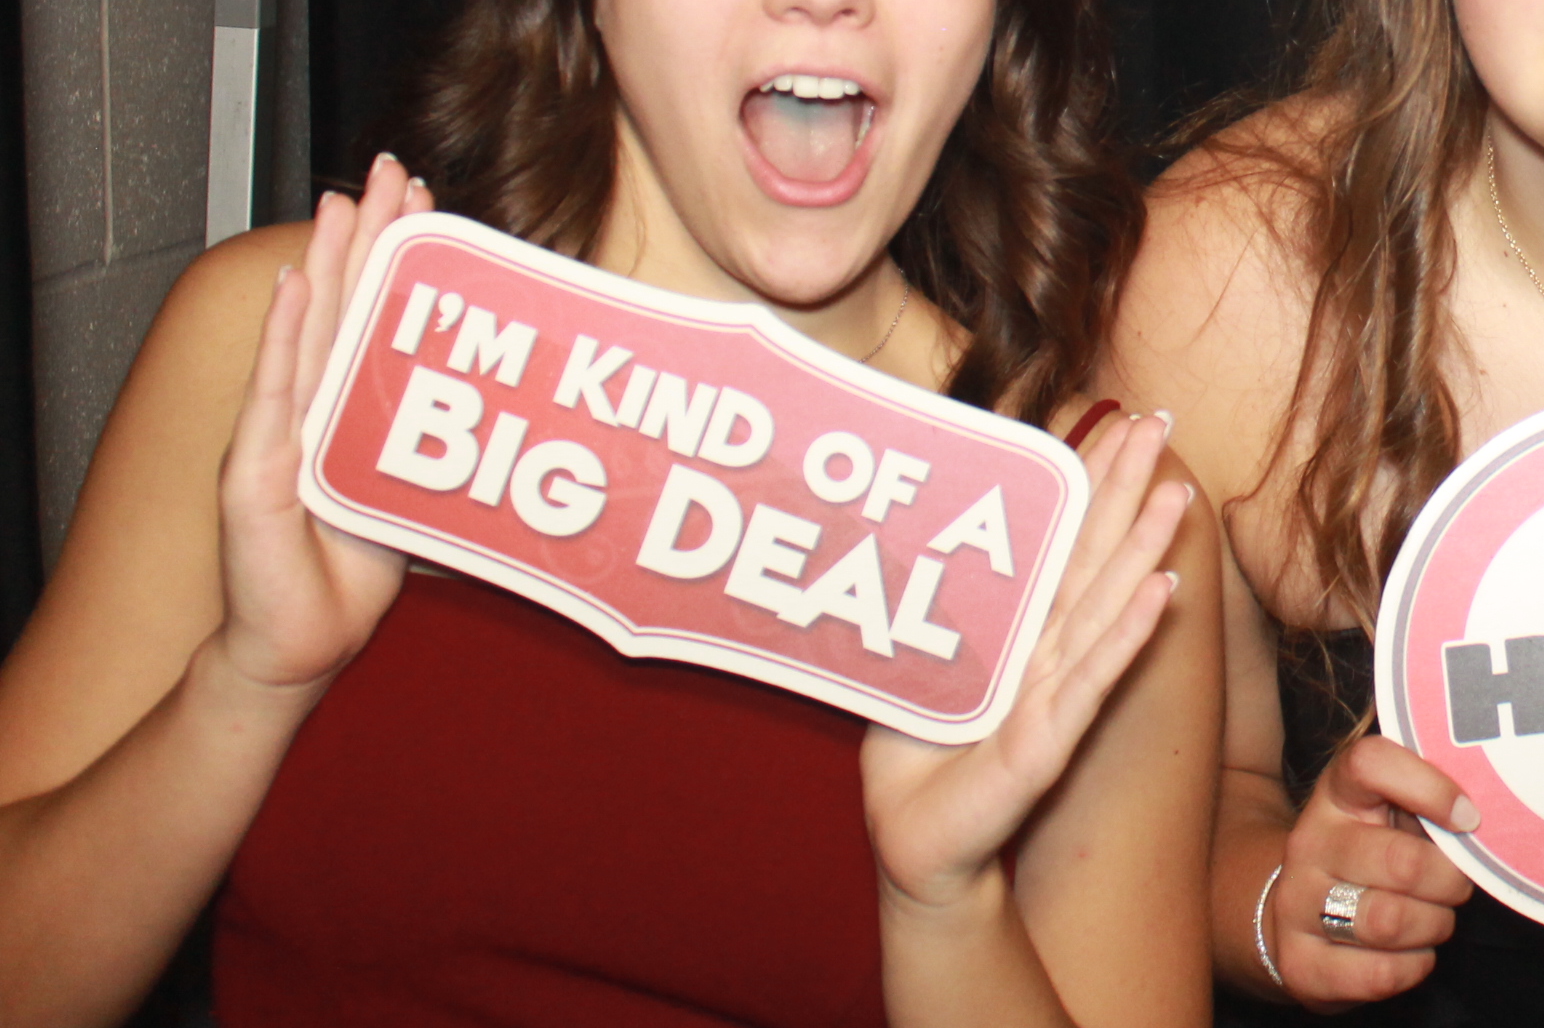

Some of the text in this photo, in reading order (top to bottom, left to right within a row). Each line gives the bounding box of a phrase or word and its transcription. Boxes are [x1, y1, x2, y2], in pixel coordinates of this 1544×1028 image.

[376, 365, 961, 660] BIG DEAL
[391, 282, 1014, 578] I'M KIND OF A
